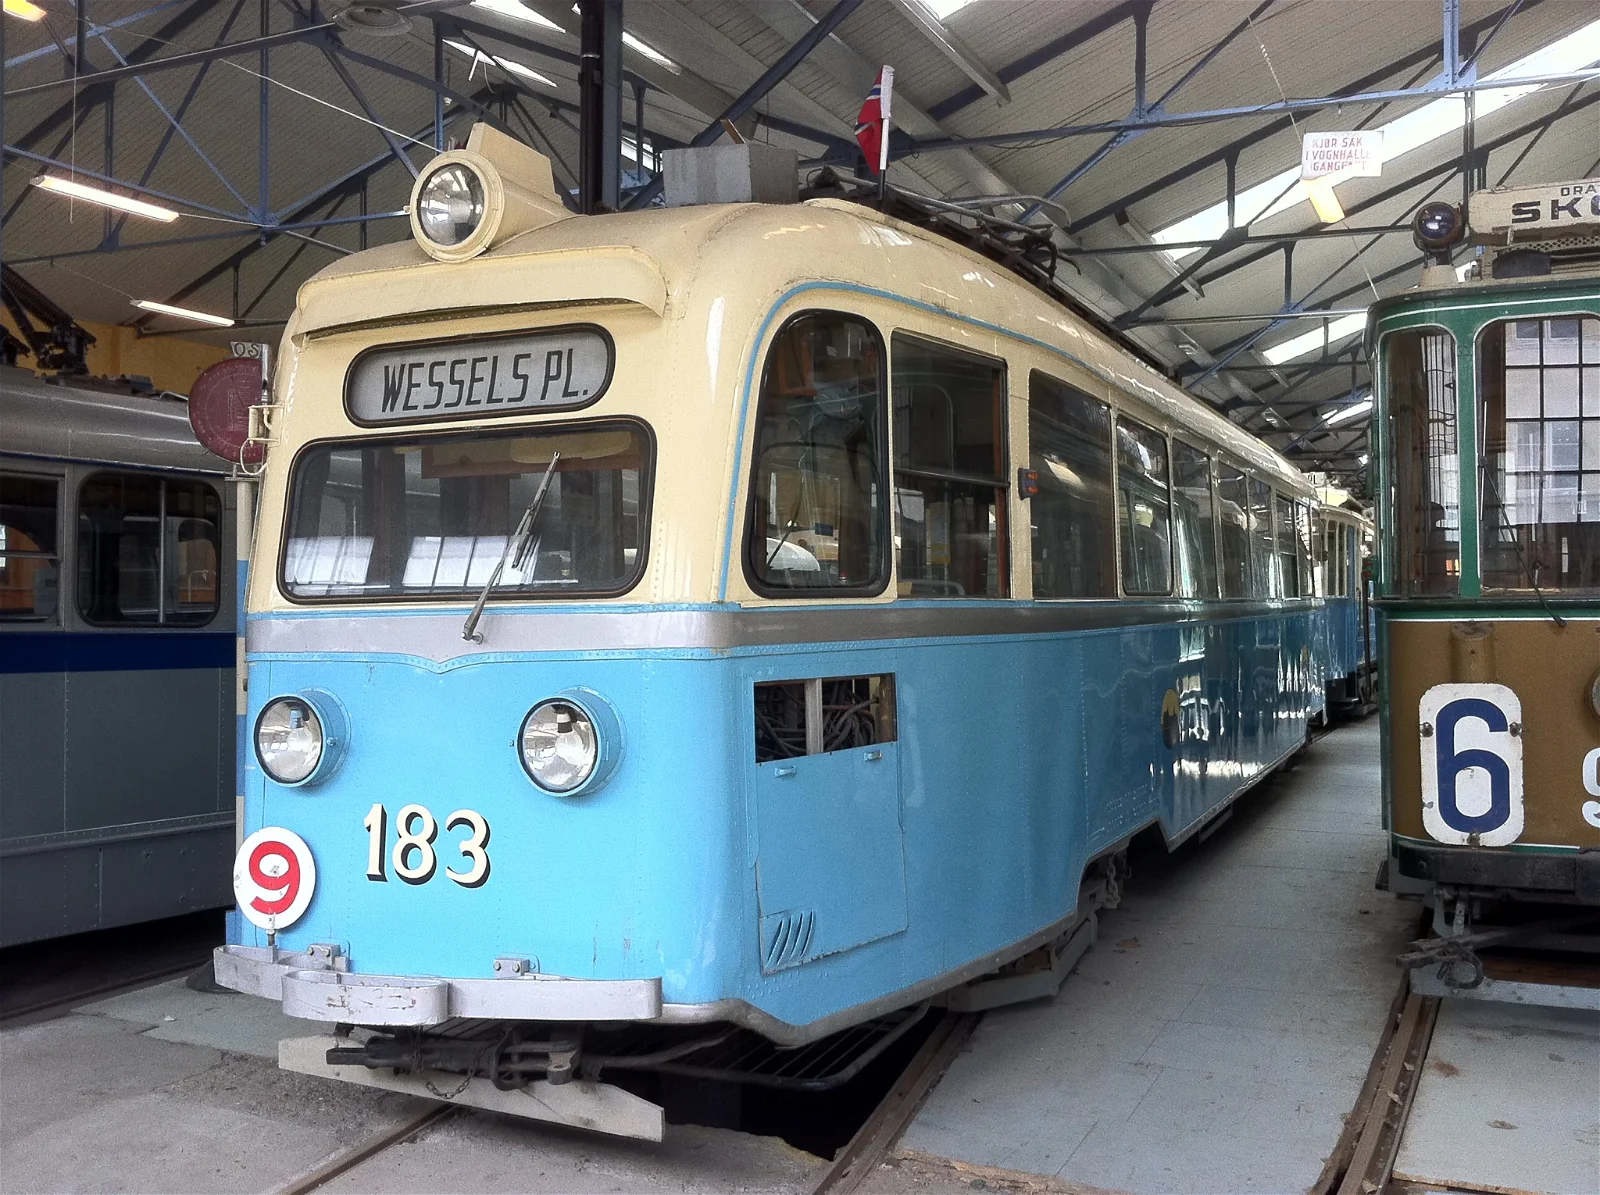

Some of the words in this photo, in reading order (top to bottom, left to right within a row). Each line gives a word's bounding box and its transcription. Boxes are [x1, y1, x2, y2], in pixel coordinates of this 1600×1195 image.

[381, 352, 532, 413] WESSELS
[540, 347, 589, 401] PL.
[1435, 697, 1511, 834] 6
[249, 840, 301, 915] 9
[363, 803, 491, 889] 183
